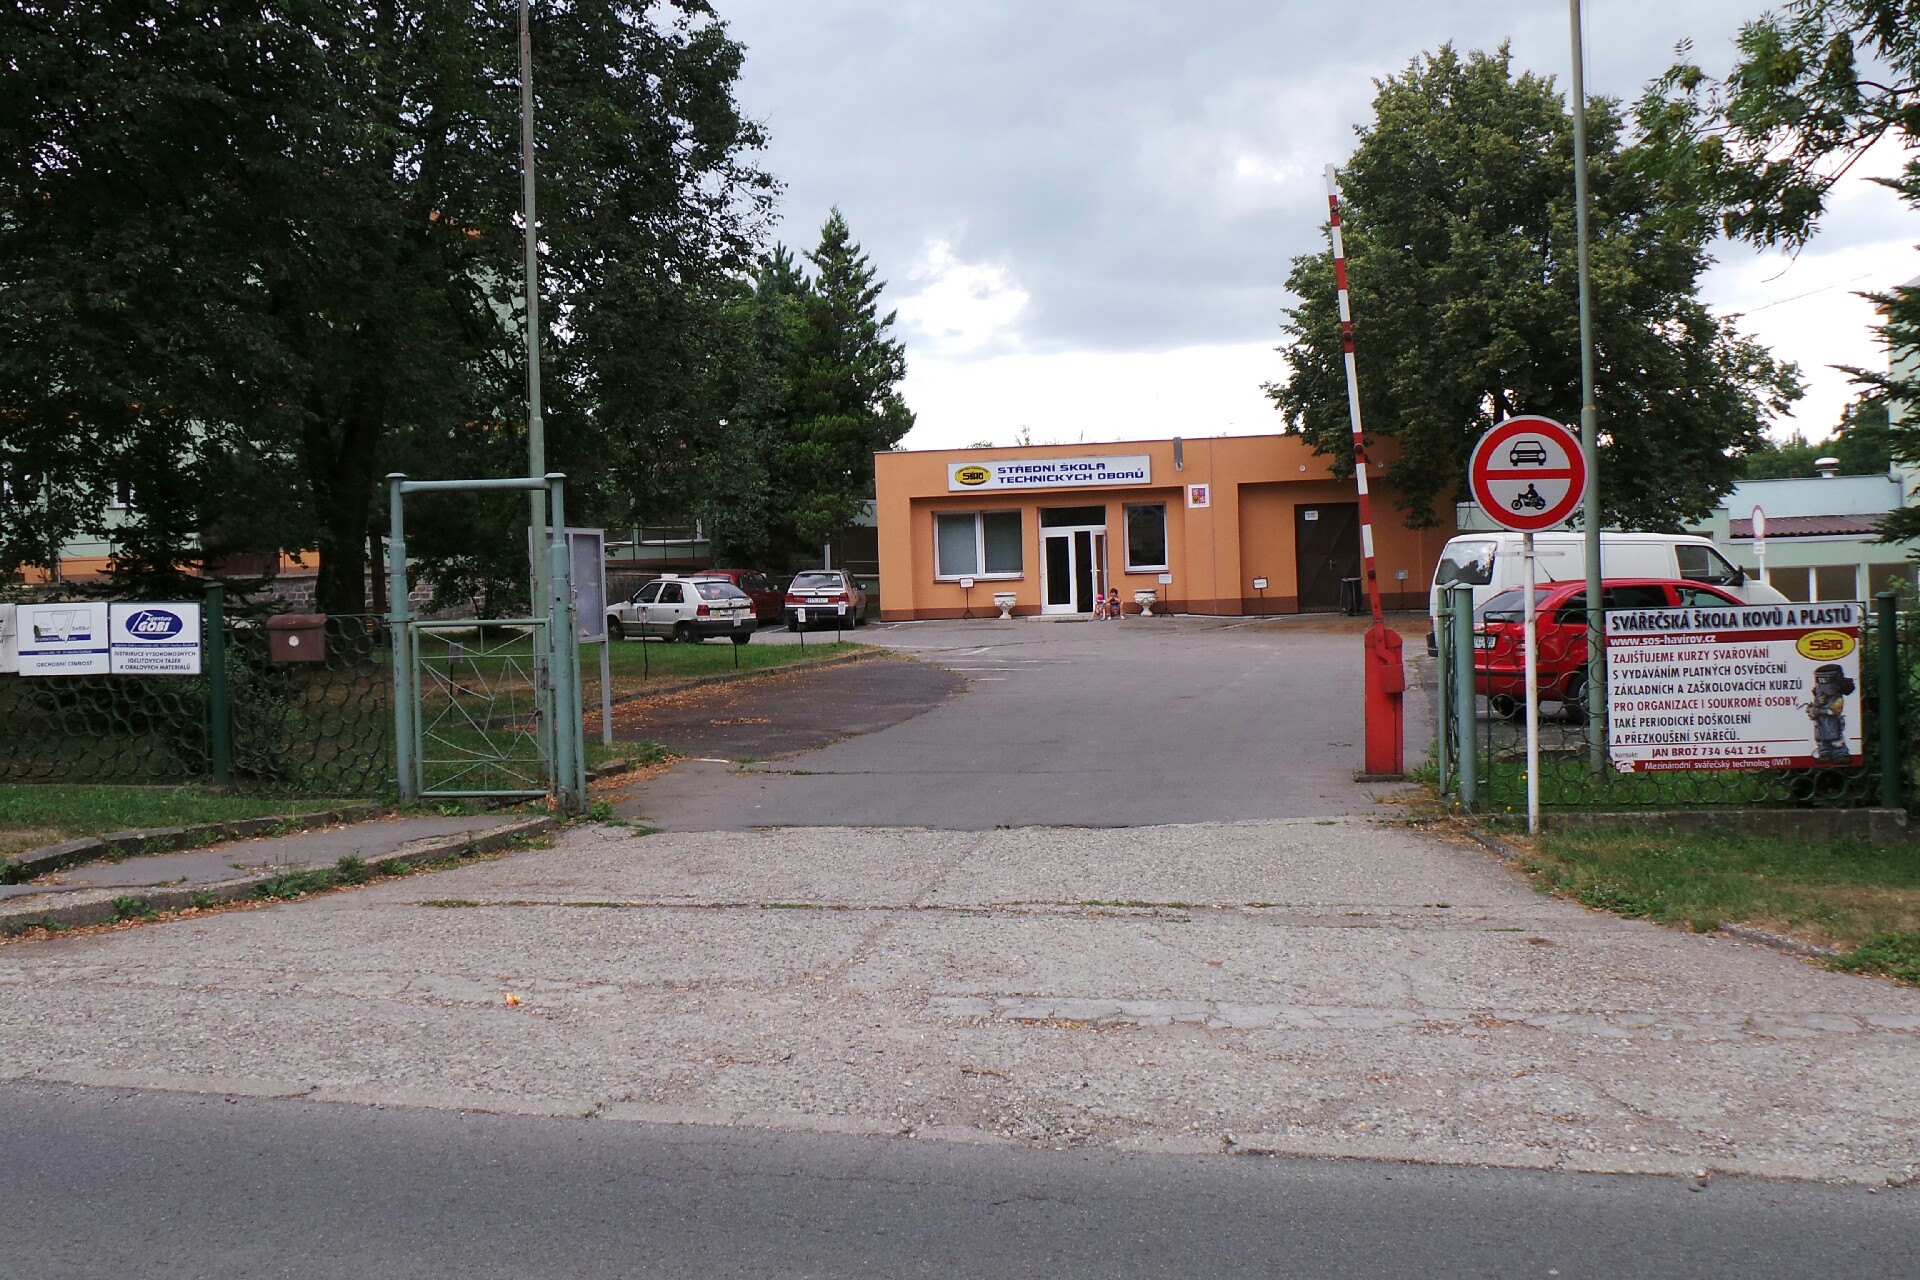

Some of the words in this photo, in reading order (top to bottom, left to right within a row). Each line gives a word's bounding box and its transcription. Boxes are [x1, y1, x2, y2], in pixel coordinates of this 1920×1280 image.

[997, 463, 1056, 474] STŘEDNÍ
[1060, 462, 1106, 472] ŠKOLA
[998, 472, 1093, 484] TECHNICKÝCH
[1097, 467, 1144, 480] OBORŮ
[1612, 610, 1691, 631] SVÁŘEČSKÁ
[1694, 609, 1739, 628] ŠKOLA
[1743, 607, 1782, 627] KOVŮ
[1787, 610, 1797, 625] A
[1801, 604, 1851, 624] PLASTŮ
[137, 621, 171, 632] GOBI
[1610, 634, 1716, 646] www.sos-havirov.cz
[1613, 650, 1674, 664] ZAJIŠŤUJEME
[1677, 650, 1710, 661] KURZY
[1713, 645, 1770, 660] SVAŘOVÁNÍ
[36, 660, 67, 668] OBCHODNÍ
[1613, 669, 1618, 680] S
[1621, 665, 1680, 679] VYDÁVÁNÍM
[1683, 663, 1731, 677] PLATNÝCH
[1734, 661, 1787, 676] OSVĚDČENÍ
[1614, 682, 1674, 696] ZÁKLADNÍCH
[1677, 683, 1684, 694] A
[1687, 678, 1766, 693] ZAŠKOLOVACÍCH
[1769, 677, 1802, 690] KURZŮ
[1614, 701, 1634, 712] PRO
[1637, 699, 1698, 711] ORGANIZACE
[1701, 699, 1705, 709] I
[1707, 695, 1761, 709] SOUKROMÉ
[1764, 696, 1799, 707] OSOBY,
[1614, 715, 1636, 728] TAKÉ
[1639, 713, 1694, 727] PERIODICKÉ
[1697, 711, 1751, 726] DOŠKOLENÍ
[1615, 734, 1621, 744] A
[1625, 729, 1690, 744] PŘEZKOUŠENÍ
[1694, 728, 1739, 742] SVÁŘEČŮ.
[1652, 748, 1669, 758] JAN
[1672, 745, 1698, 757] BROŽ
[1701, 747, 1721, 756] 734
[1724, 746, 1744, 755] 641
[1747, 745, 1767, 754] 216
[1644, 761, 1691, 770] Mezinárodní
[1694, 760, 1730, 770] svářečský
[1732, 758, 1770, 769] technolog
[1772, 758, 1791, 767] (IWT)
